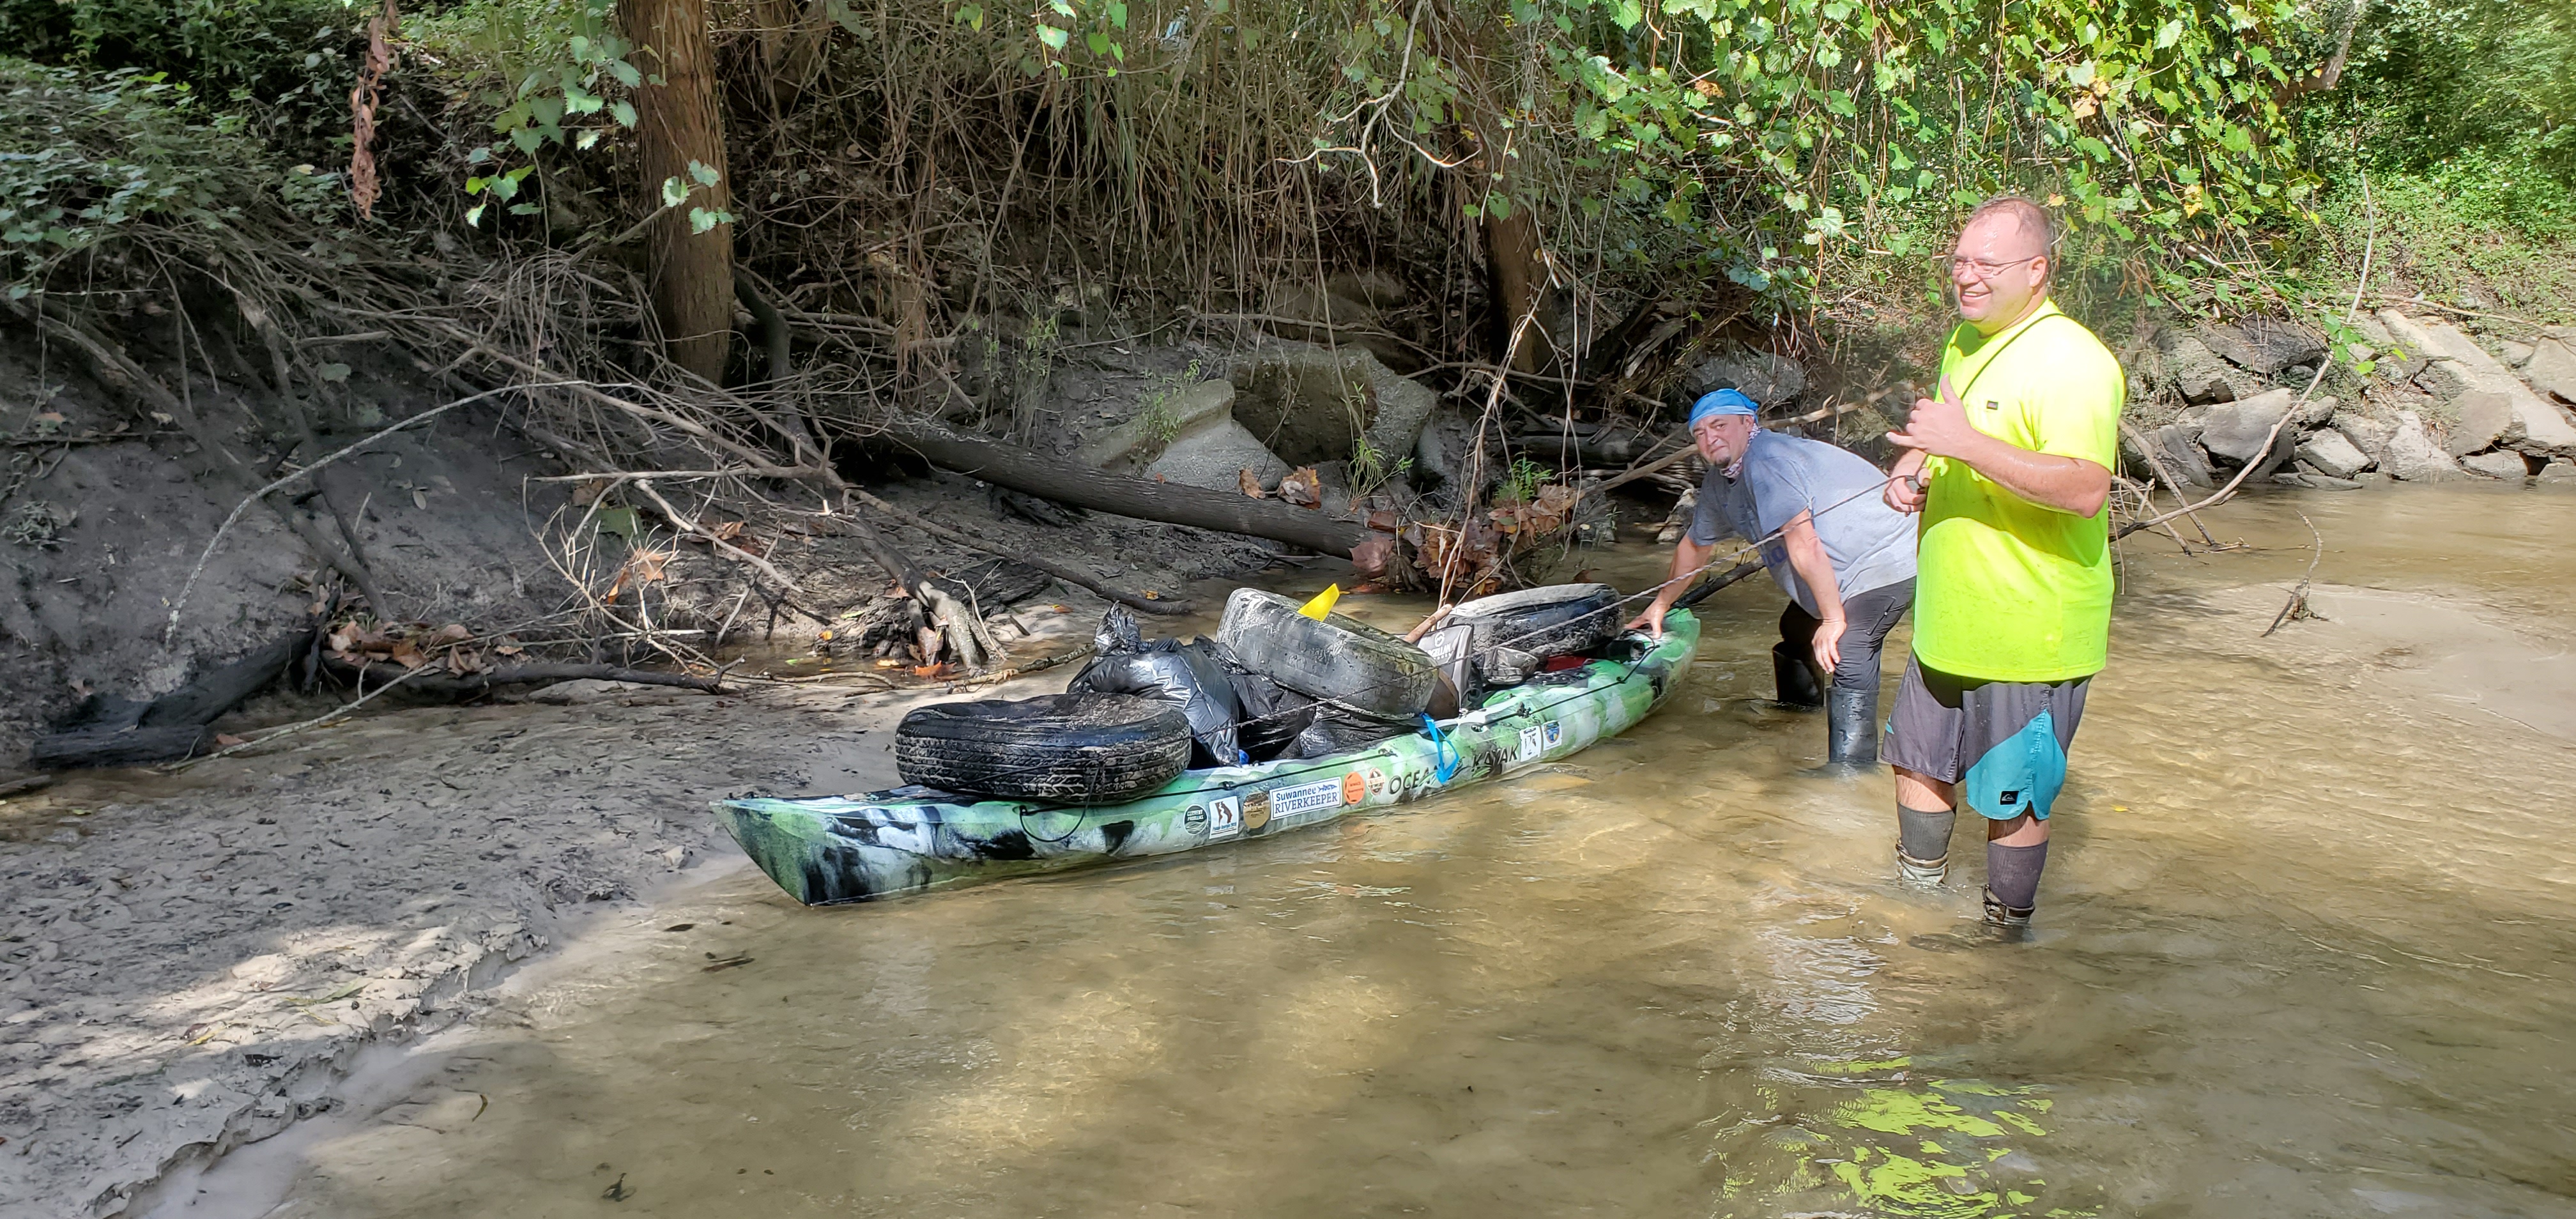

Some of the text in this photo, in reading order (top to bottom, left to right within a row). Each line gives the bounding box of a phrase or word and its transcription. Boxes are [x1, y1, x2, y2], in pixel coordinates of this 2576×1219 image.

[1471, 743, 1519, 769] KAYAK
[1275, 792, 1338, 814] RIVERKEEPER
[1276, 787, 1316, 802] Suwannee
